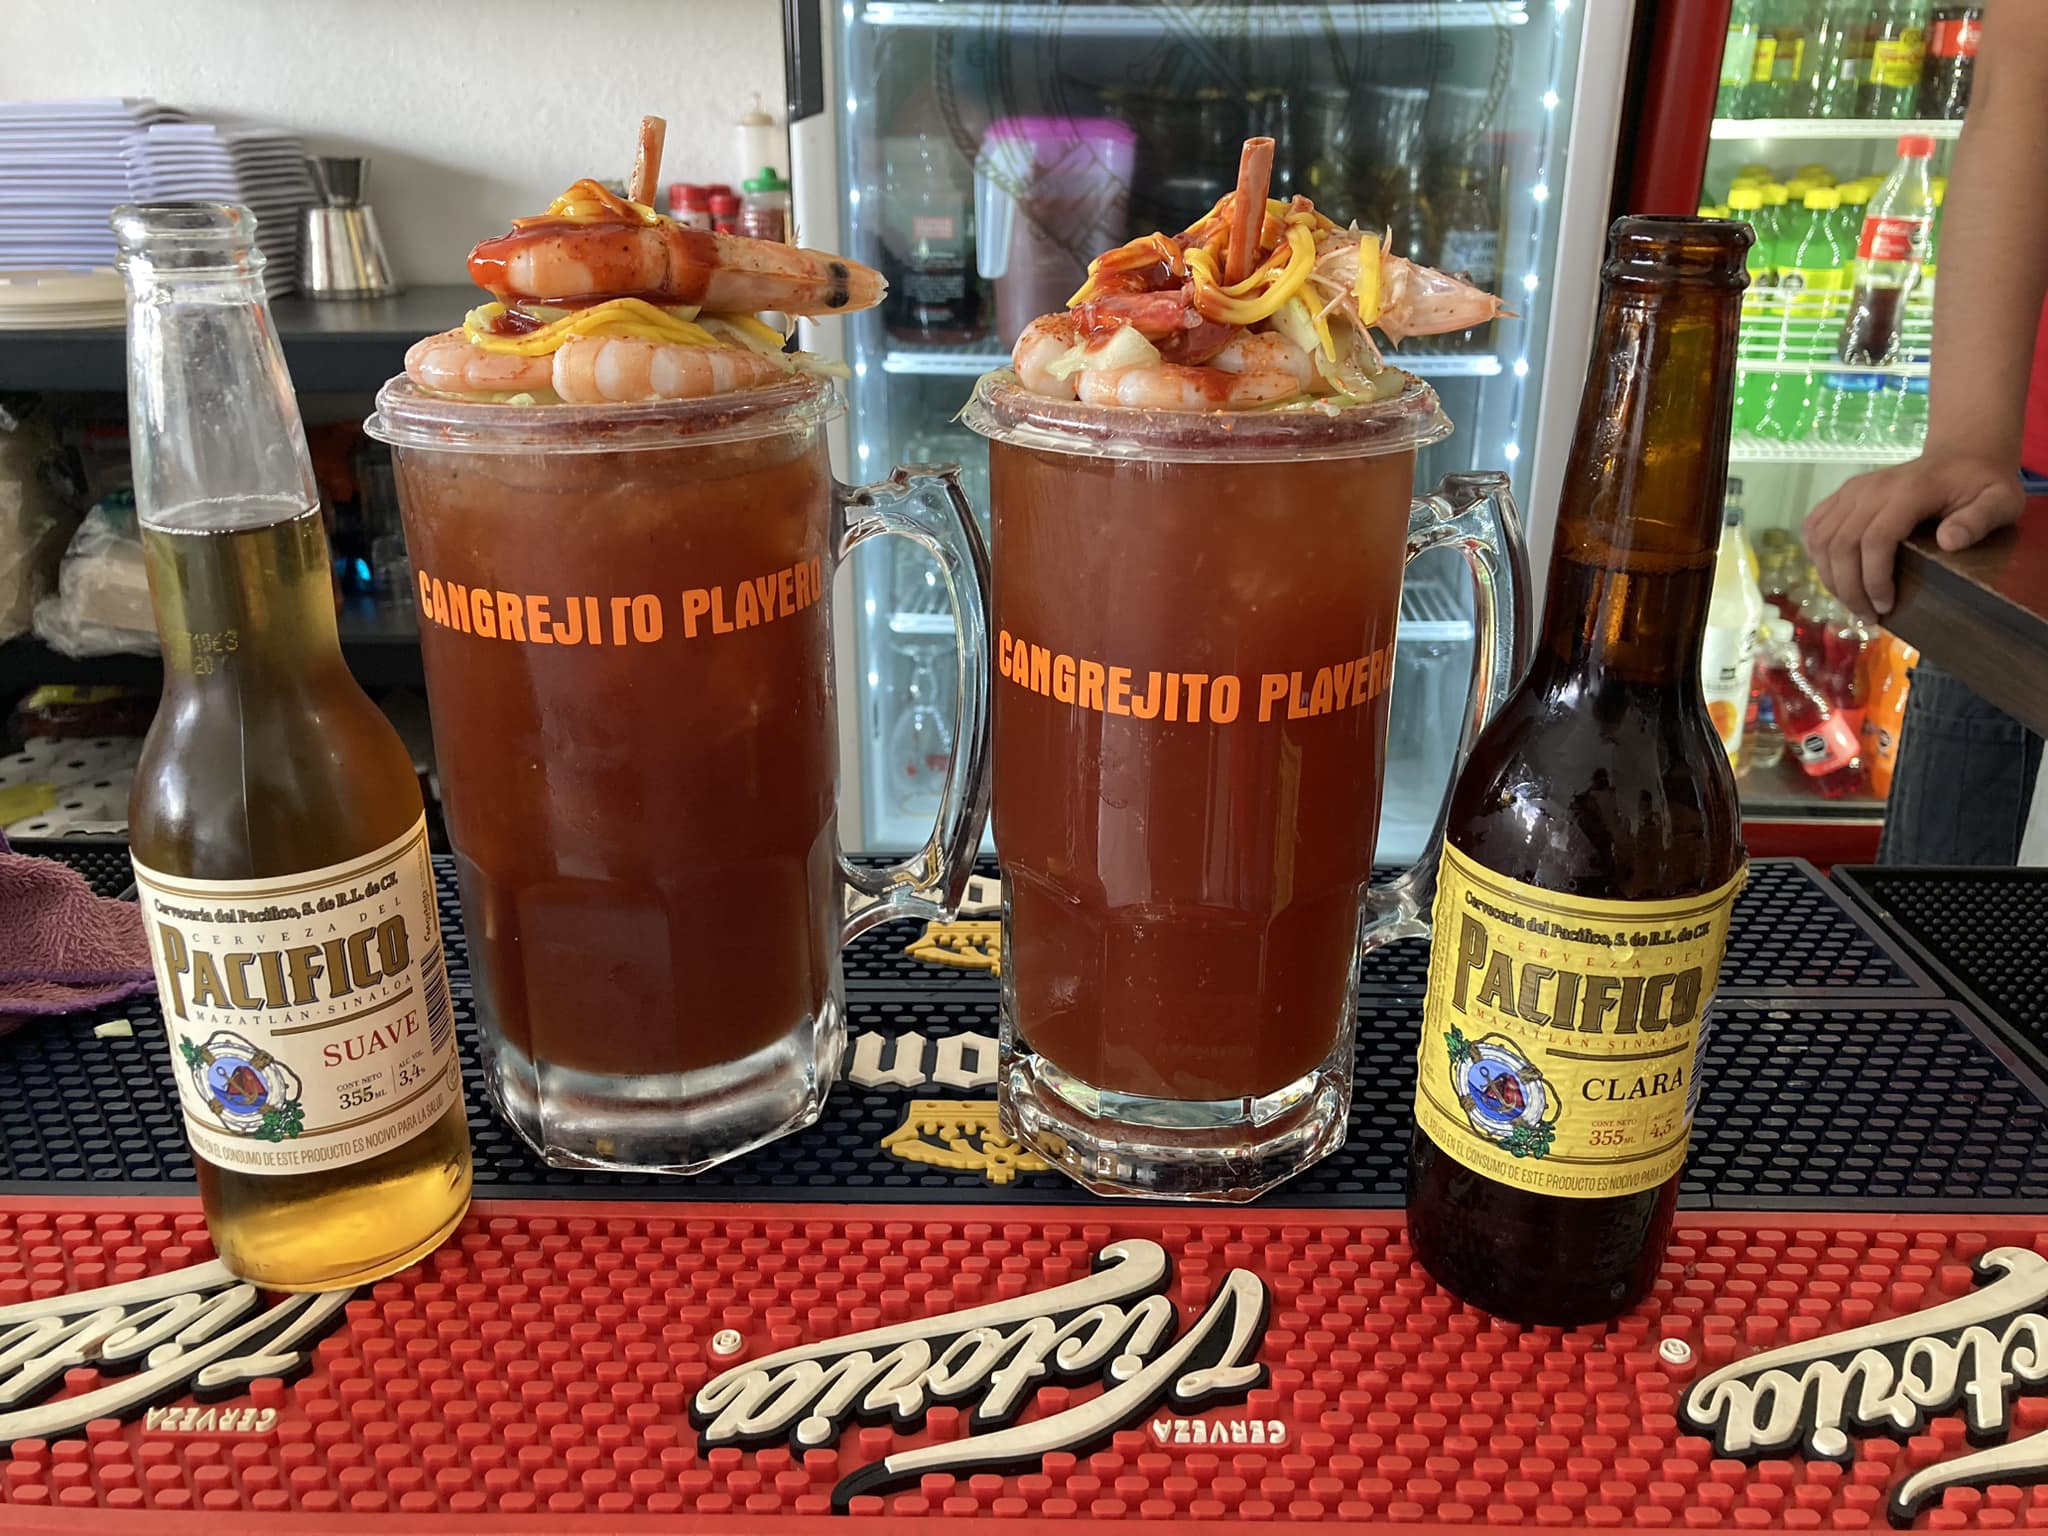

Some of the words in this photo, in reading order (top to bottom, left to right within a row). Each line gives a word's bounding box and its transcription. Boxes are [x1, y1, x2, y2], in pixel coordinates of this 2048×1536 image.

[418, 570, 664, 646] CANGREJITO
[682, 555, 822, 638] PLAYERO
[998, 629, 1242, 724] CANGREJITO
[192, 922, 337, 945] CERVEZA
[359, 896, 401, 923] DEL
[214, 908, 237, 923] del
[317, 896, 335, 912] de
[1526, 917, 1549, 936] del
[1629, 931, 1648, 947] de
[157, 914, 410, 1022] PACIFICO
[1451, 912, 1703, 1035] PACIFICO
[1497, 934, 1641, 969] CERVEZA
[327, 974, 411, 1014] SINALOA
[323, 1008, 420, 1068] SUAVE
[1581, 1066, 1684, 1102] CLARA
[222, 1145, 262, 1166] CONSUMO
[263, 1150, 277, 1167] DE
[276, 1149, 300, 1167] ESTE
[300, 1140, 351, 1165] PRODUCTO
[352, 1137, 366, 1154] ES
[365, 1125, 397, 1149] NOCIVO
[397, 1114, 418, 1137] PARA
[416, 1107, 428, 1125] LA
[1465, 1145, 1507, 1176] CONSUMO
[1507, 1165, 1521, 1183] DE
[1521, 1168, 1546, 1186] ESTE
[1545, 1173, 1597, 1193] PRODUCTO
[1597, 1176, 1609, 1191] ES
[1609, 1172, 1640, 1190] NOCIVO
[690, 1238, 1268, 1480] Victoria
[1686, 1246, 2048, 1506] ctoria
[146, 1406, 278, 1432] CERVEZA
[1152, 1419, 1286, 1444] CERVEZA
